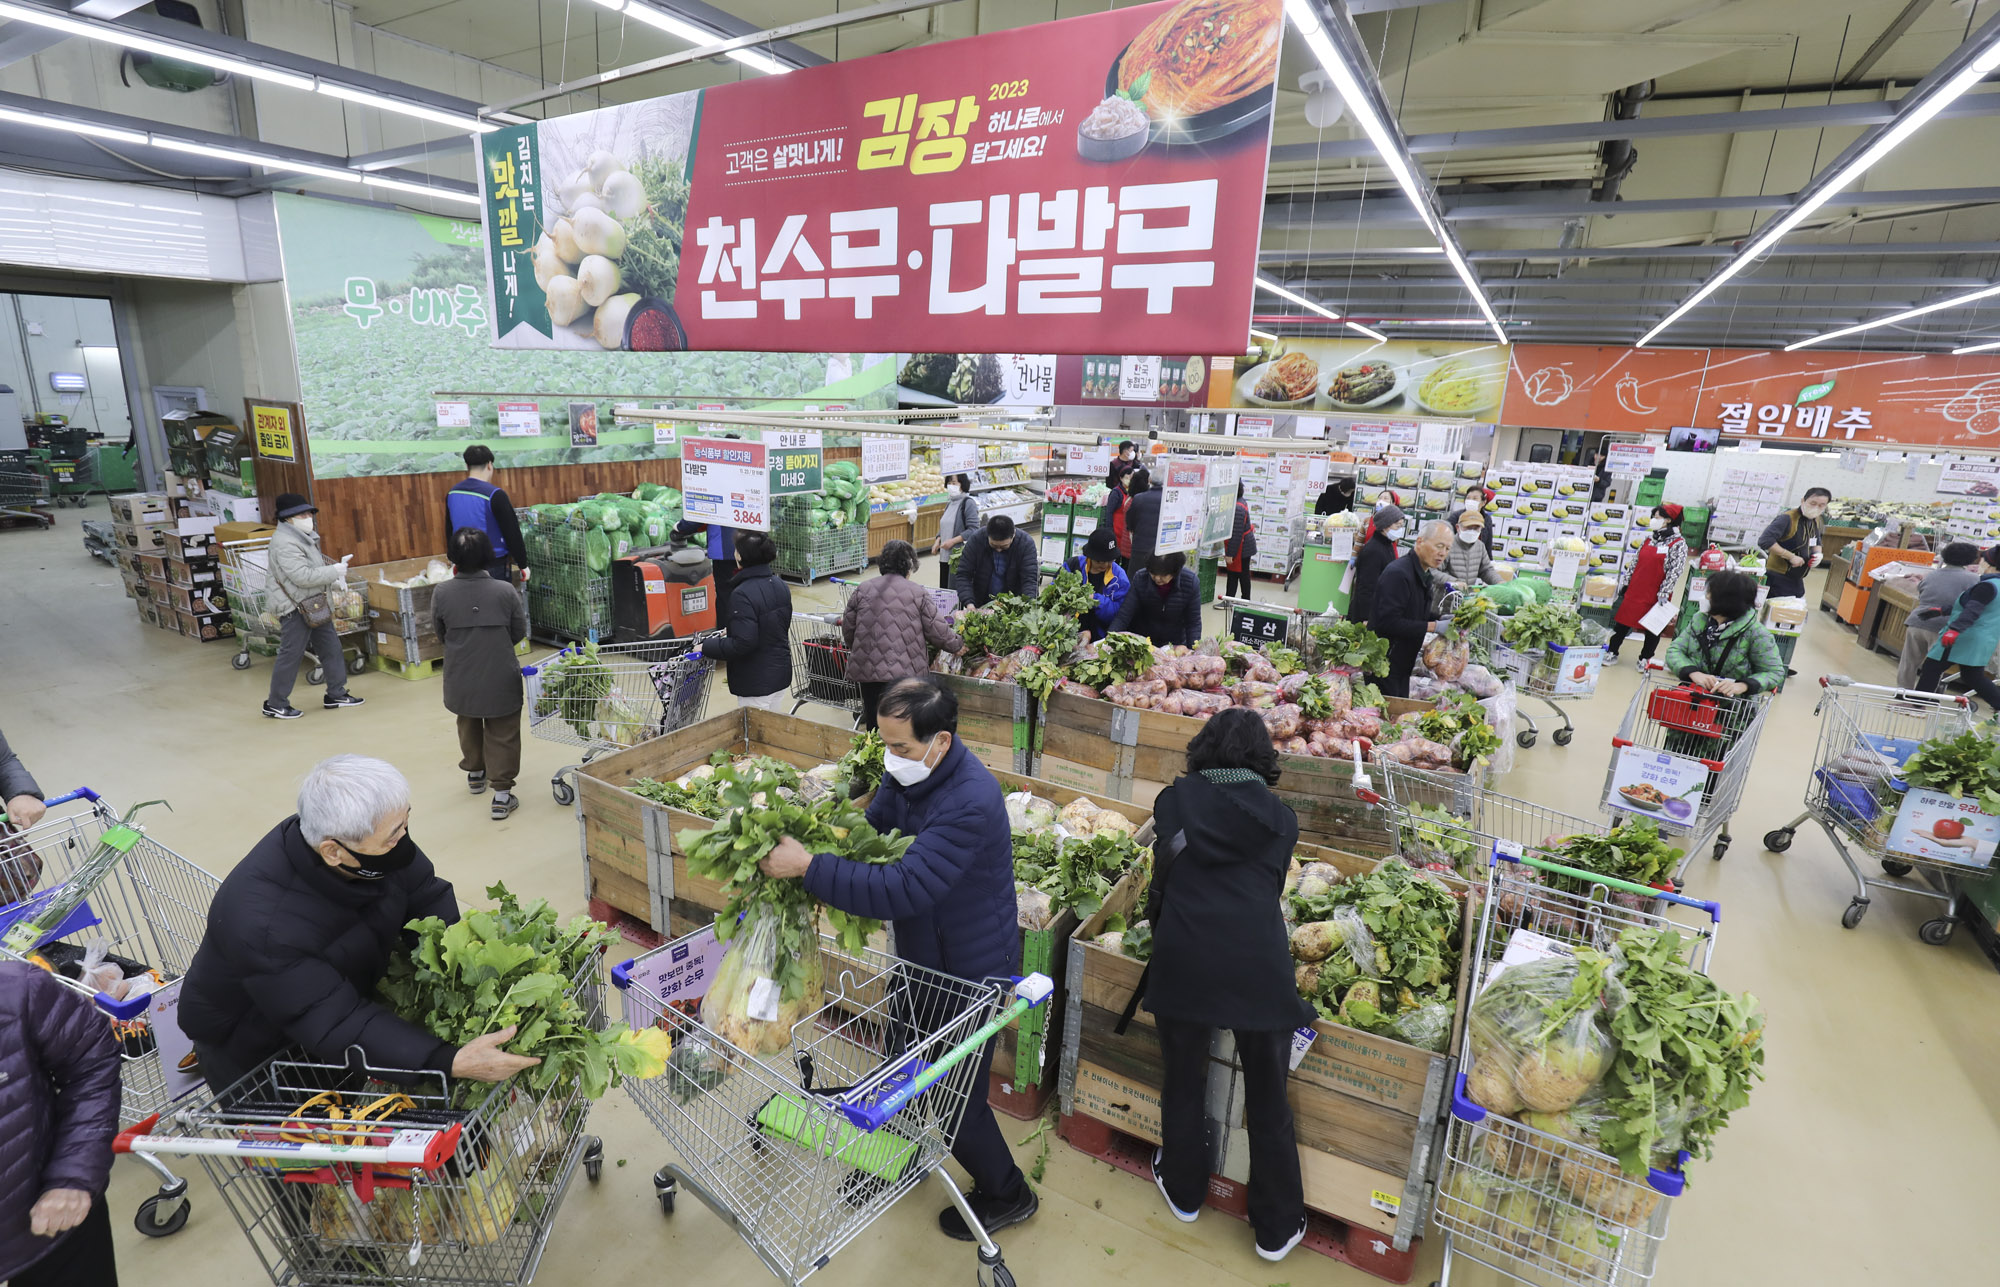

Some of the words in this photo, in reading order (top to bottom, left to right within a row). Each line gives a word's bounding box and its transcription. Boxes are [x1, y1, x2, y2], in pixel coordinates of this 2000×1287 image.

[988, 79, 1030, 102] 2023
[988, 106, 1065, 134] 하나로에서
[857, 93, 980, 176] 김장
[725, 148, 769, 175] 고객은
[772, 137, 844, 168] 살맛나게!
[970, 134, 1048, 165] 담그세요!
[517, 135, 535, 212] 김치는
[1017, 363, 1053, 392] 건나물
[1133, 364, 1149, 376] 한국
[1126, 376, 1154, 389] 농협김치
[1801, 384, 1830, 401] Fresh
[257, 413, 278, 430] 관계자
[278, 415, 286, 431] 외
[1717, 401, 1873, 440] 절임배추
[260, 432, 274, 448] 출입
[274, 434, 289, 450] 금지
[694, 446, 722, 460] 농식품부
[723, 449, 752, 464] 할인지원
[786, 453, 818, 471] 뜯어가지
[684, 463, 707, 477] 다발무
[1087, 464, 1108, 473] 3,980
[780, 472, 806, 488] 마세요
[733, 509, 762, 525] 3,864
[1641, 770, 1659, 781] 강화
[1660, 776, 1678, 786] 순무
[1642, 762, 1664, 773] 맛보면
[1665, 767, 1681, 777] 중독!
[1920, 797, 1937, 806] 하루
[1938, 800, 1956, 809] 한알
[658, 965, 684, 985] 맛보면
[686, 955, 704, 971] 중독!
[660, 980, 683, 999] 강화
[684, 968, 705, 987] 순무
[1083, 1069, 1089, 1078] 본
[1091, 1072, 1120, 1090] 컨테이너는
[883, 1089, 905, 1105] NH
